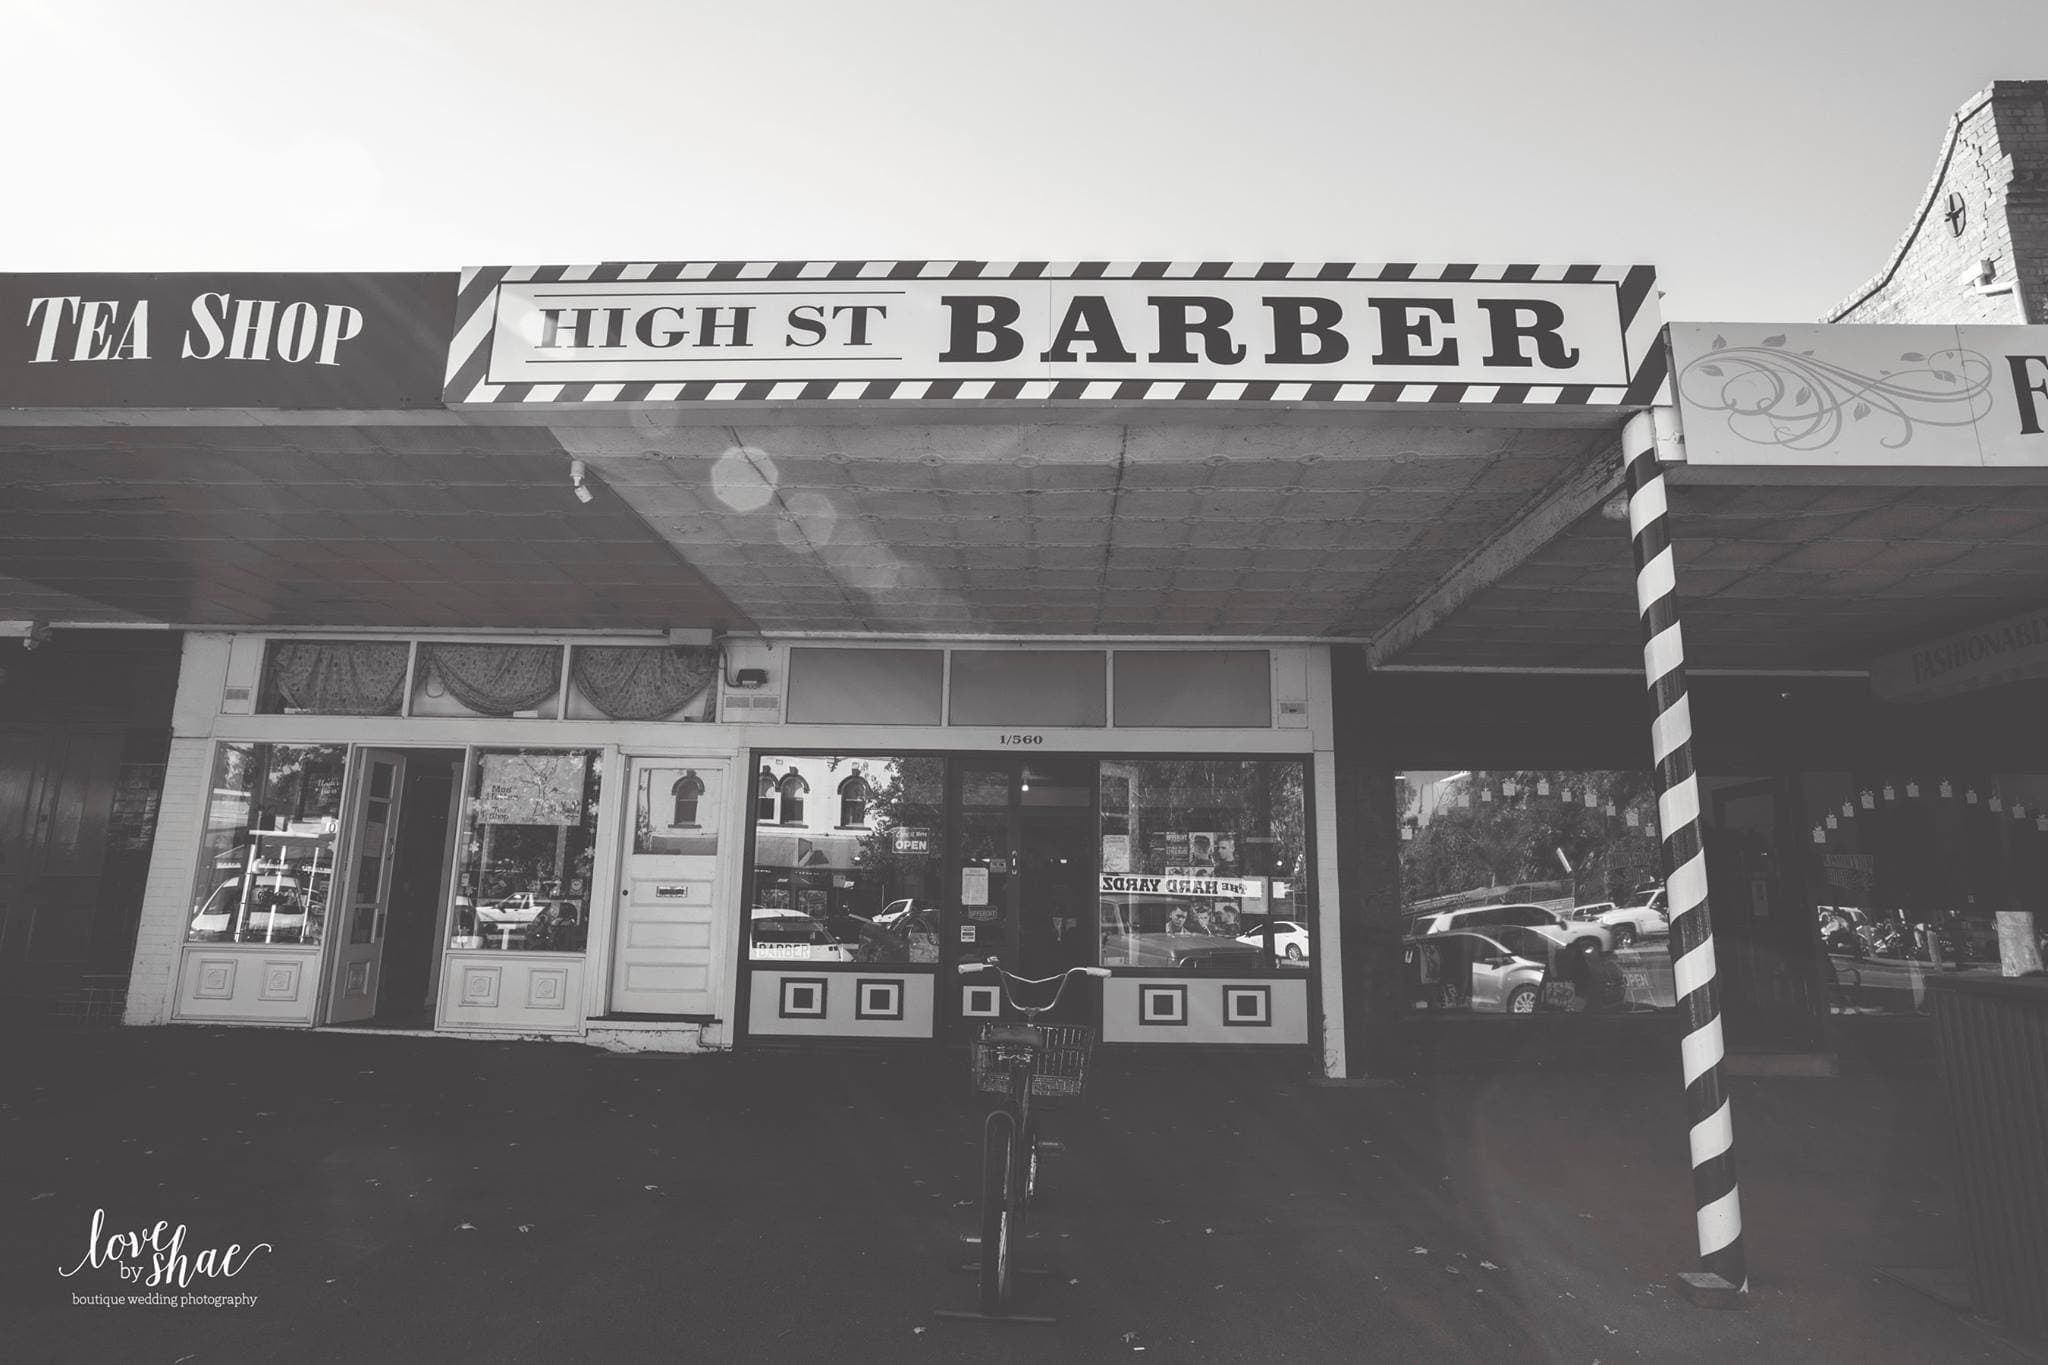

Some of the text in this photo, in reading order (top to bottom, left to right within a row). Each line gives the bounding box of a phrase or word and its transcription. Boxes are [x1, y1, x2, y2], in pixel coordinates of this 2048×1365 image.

[27, 293, 363, 365] TEA SHOP
[534, 296, 1579, 368] HIGH ST BARBER
[1911, 616, 2048, 687] FASHIONABL
[1000, 735, 1043, 745] 1/560
[895, 840, 927, 850] OPEN
